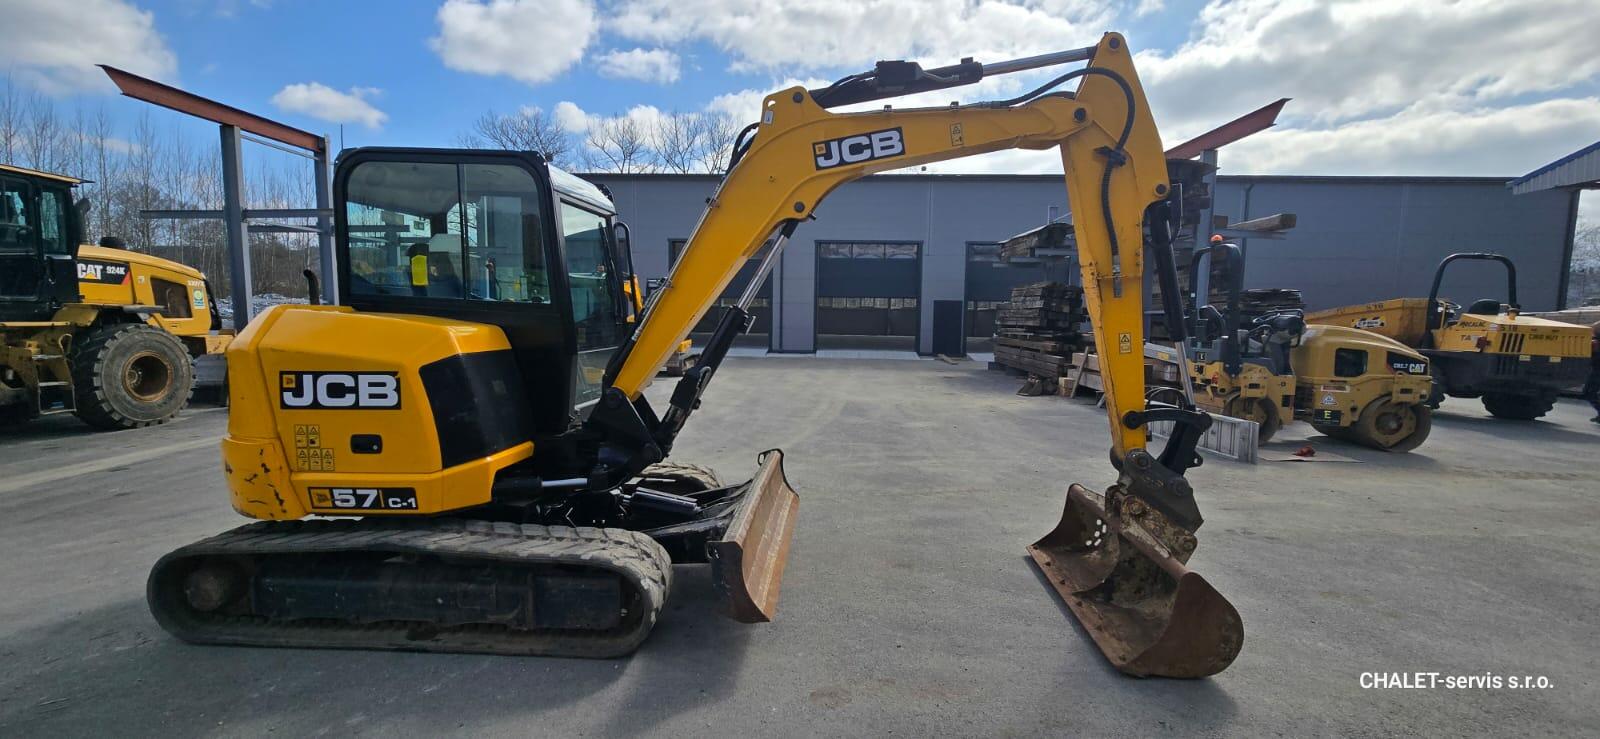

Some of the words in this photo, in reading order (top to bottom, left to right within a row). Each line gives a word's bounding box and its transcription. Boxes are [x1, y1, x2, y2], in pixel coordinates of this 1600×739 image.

[817, 130, 903, 168] JCB
[77, 263, 103, 280] CAT
[106, 266, 126, 275] 924K
[1409, 363, 1426, 373] CAT
[282, 373, 399, 407] JCB
[1324, 410, 1332, 419] E
[333, 488, 379, 508] 57
[388, 497, 417, 508] C-1
